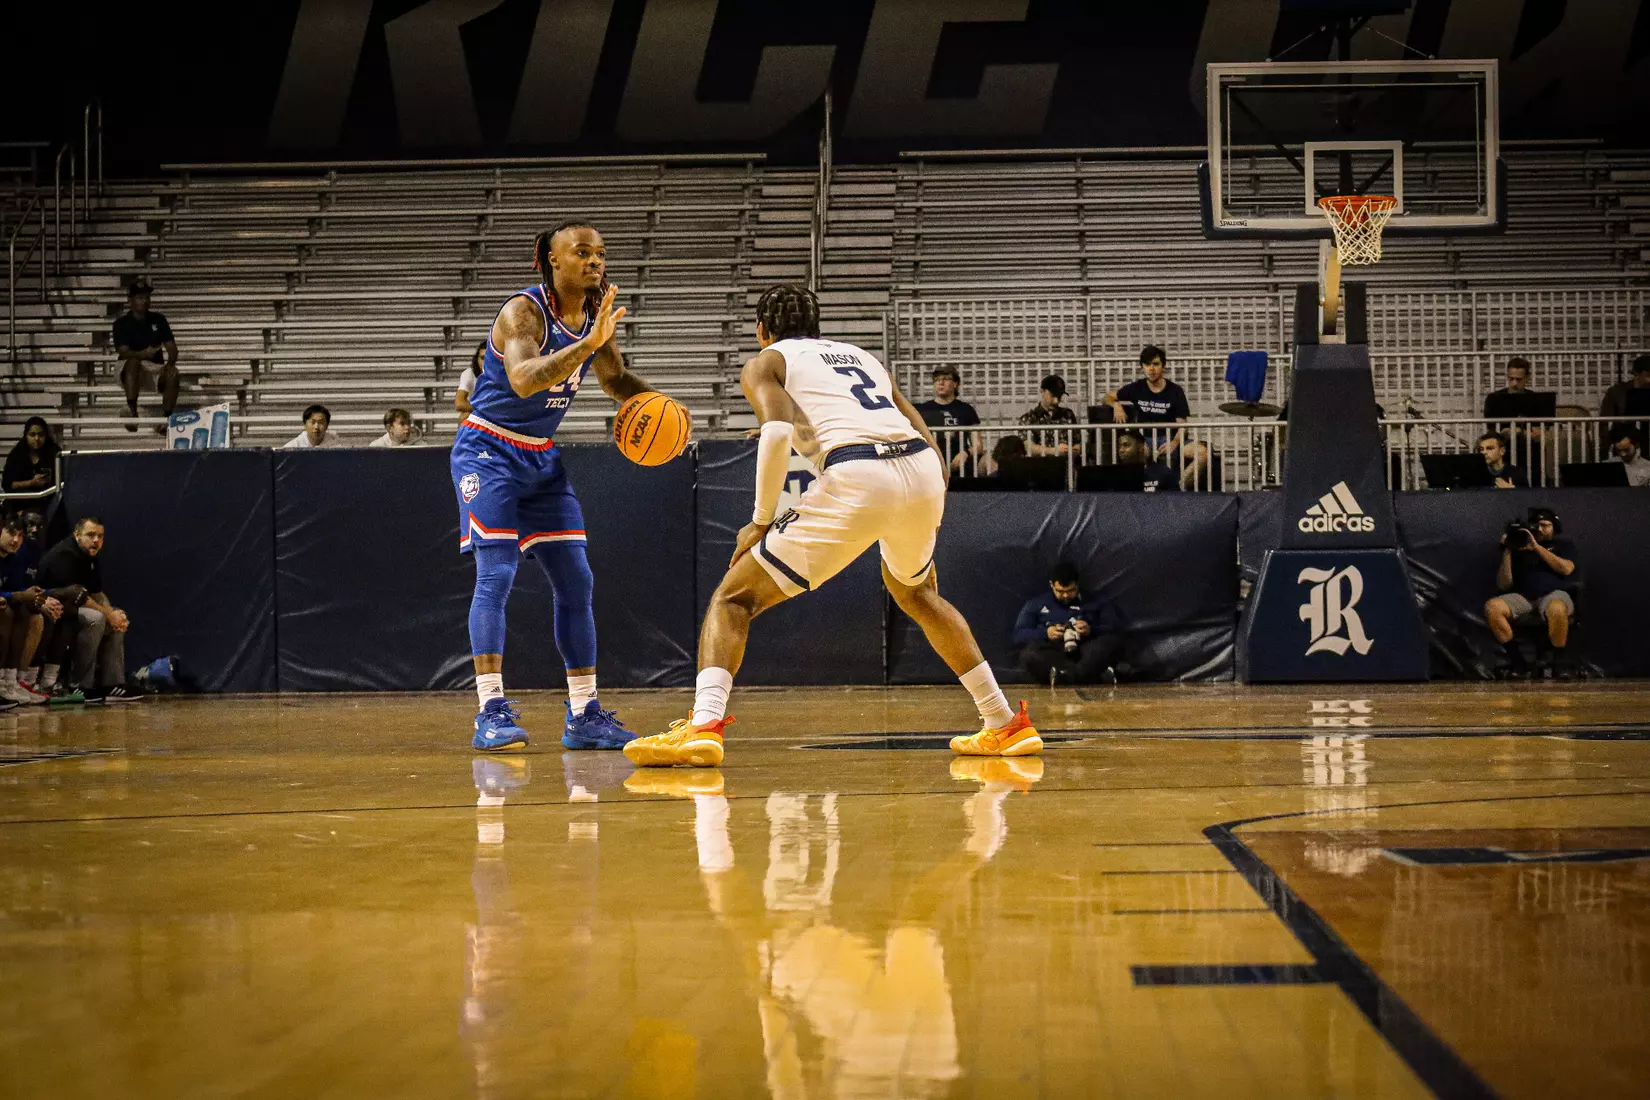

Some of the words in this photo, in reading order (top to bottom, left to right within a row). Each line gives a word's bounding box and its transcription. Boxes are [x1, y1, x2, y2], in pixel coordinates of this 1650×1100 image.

[1219, 219, 1248, 227] SPALDING
[820, 353, 863, 366] MASON
[832, 366, 895, 410] 2
[630, 413, 652, 449] NCAA
[1298, 512, 1375, 533] adidas
[1297, 564, 1375, 656] R
